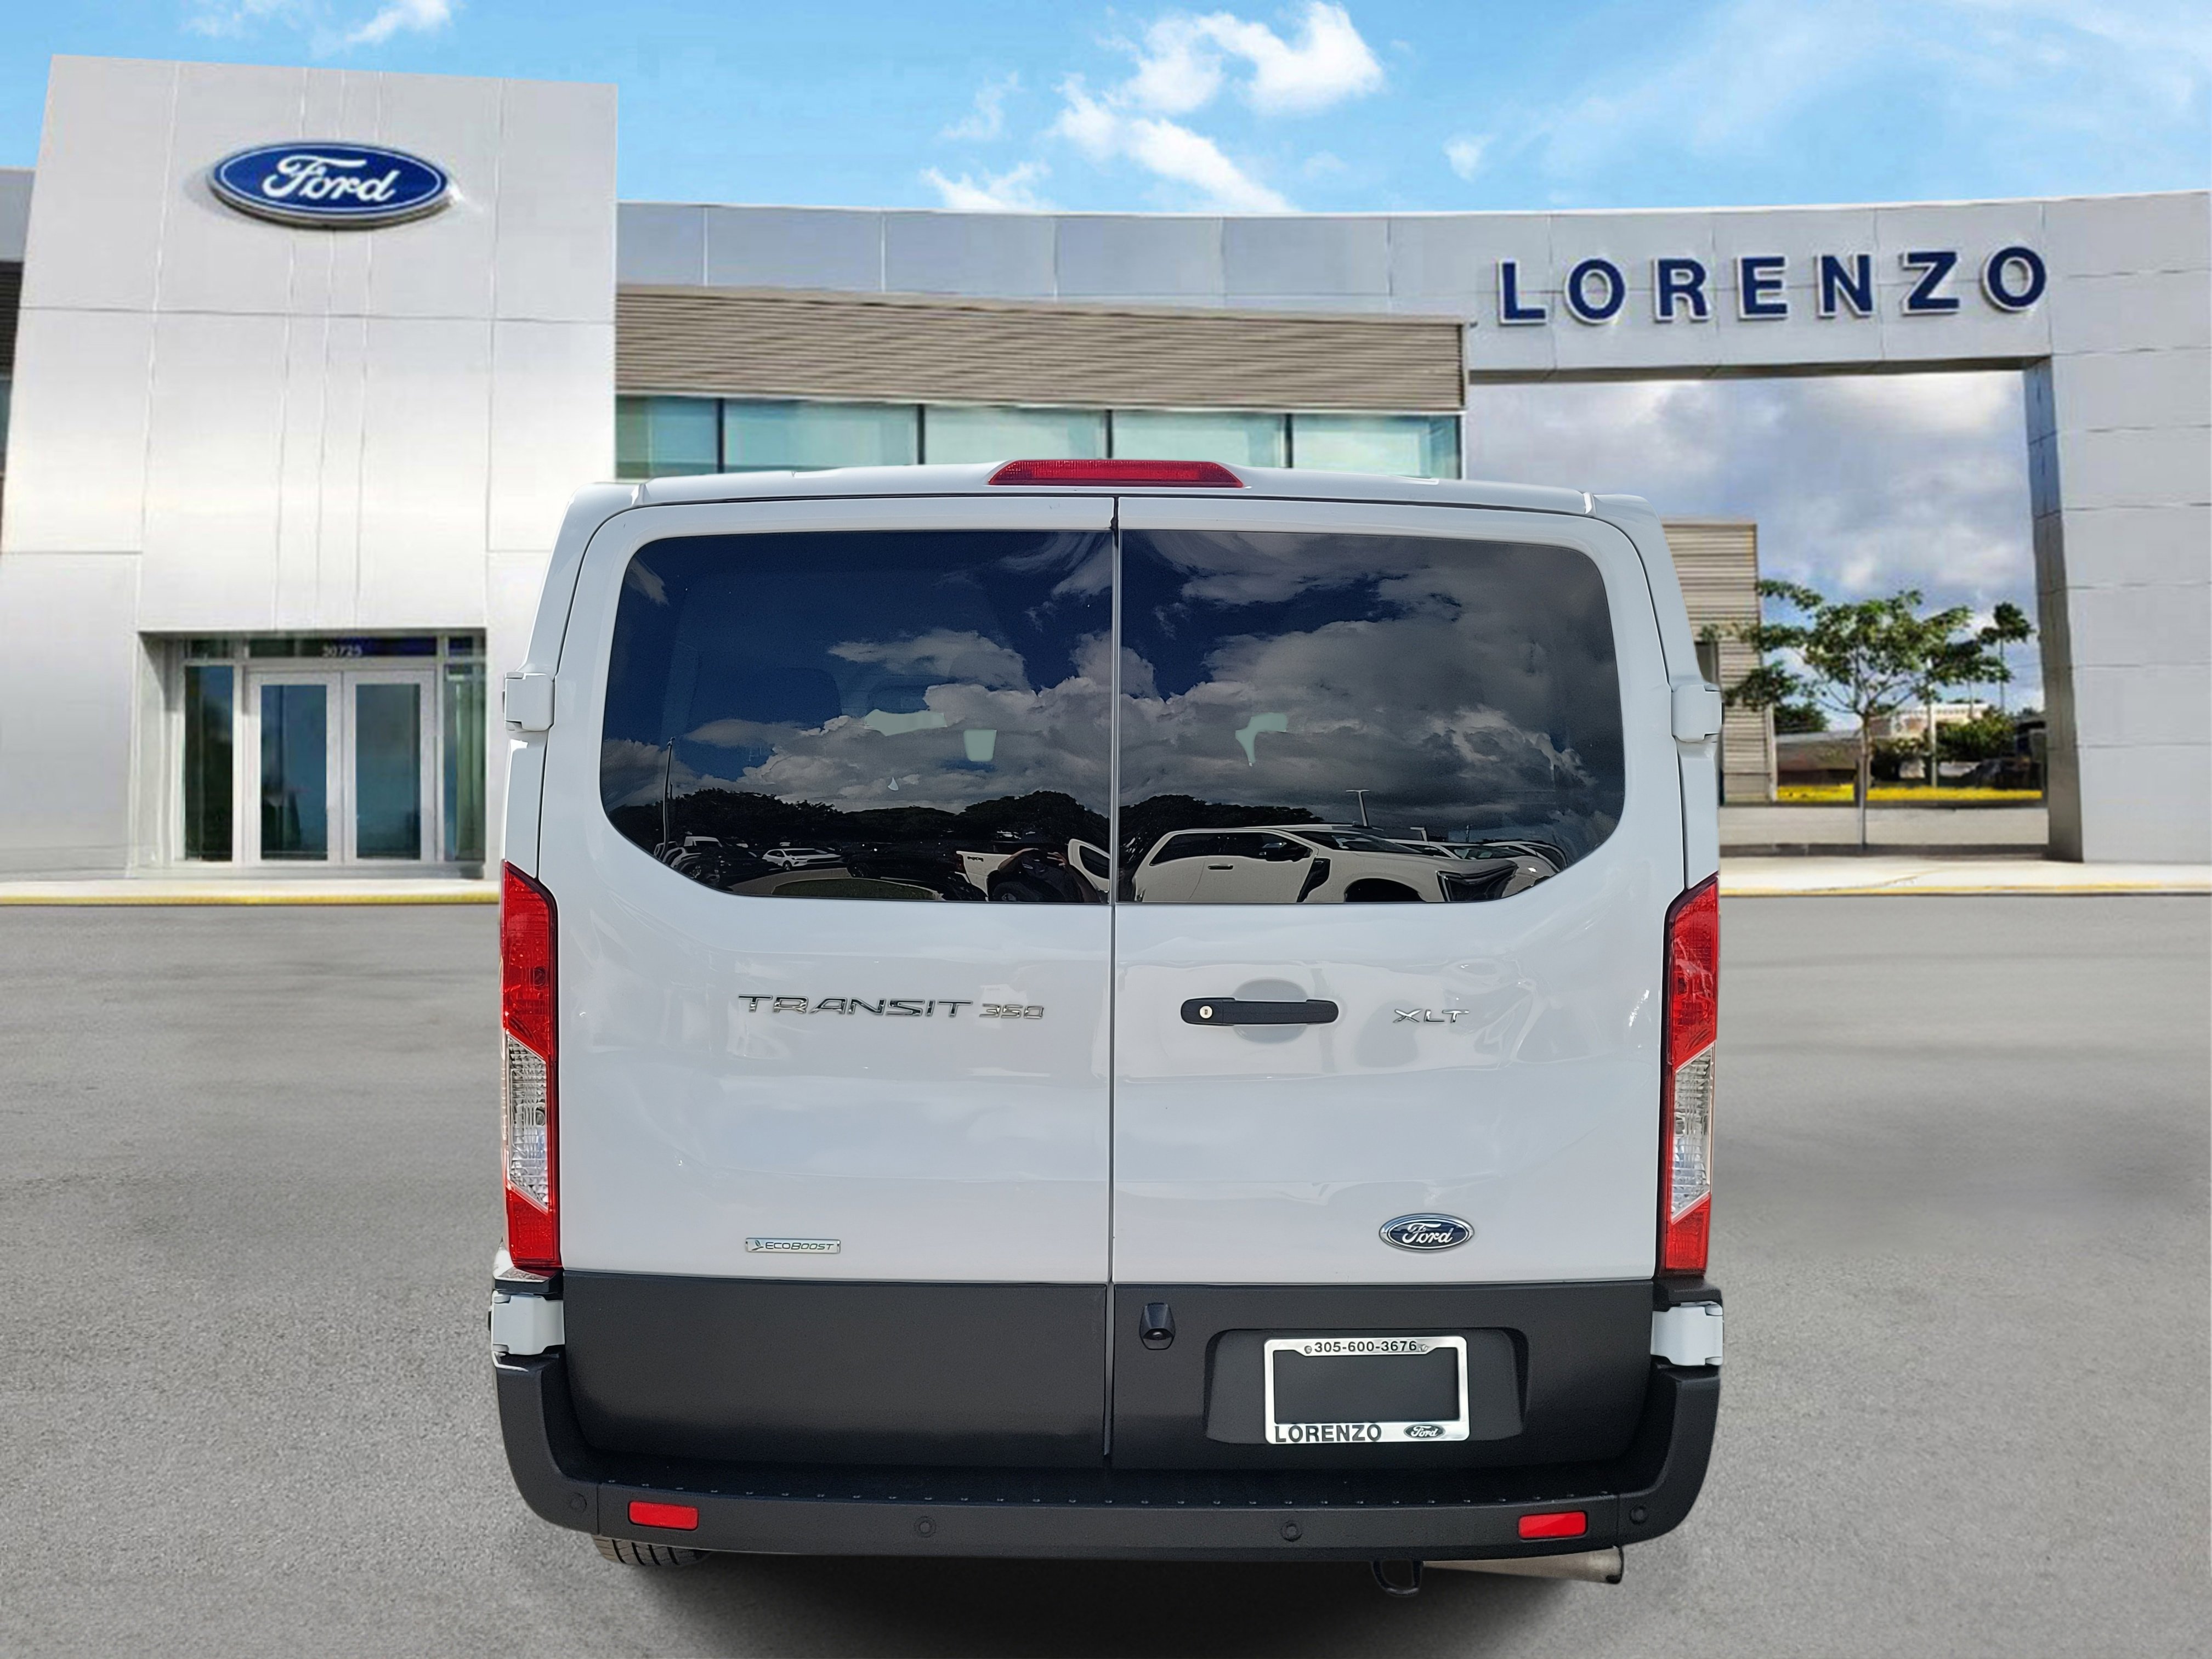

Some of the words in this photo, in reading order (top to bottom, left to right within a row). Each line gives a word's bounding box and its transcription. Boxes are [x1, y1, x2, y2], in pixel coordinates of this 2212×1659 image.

[262, 154, 400, 201] Ford
[1498, 246, 2047, 325] LORENZO
[738, 994, 973, 1018] TRANSIT
[979, 1003, 1044, 1020] 350
[1393, 1009, 1470, 1023] XLT
[1402, 1222, 1454, 1243] Ford
[1314, 1340, 1417, 1353] 305-600-3676
[1275, 1423, 1382, 1442] LORENZO
[1410, 1425, 1439, 1438] Ford
